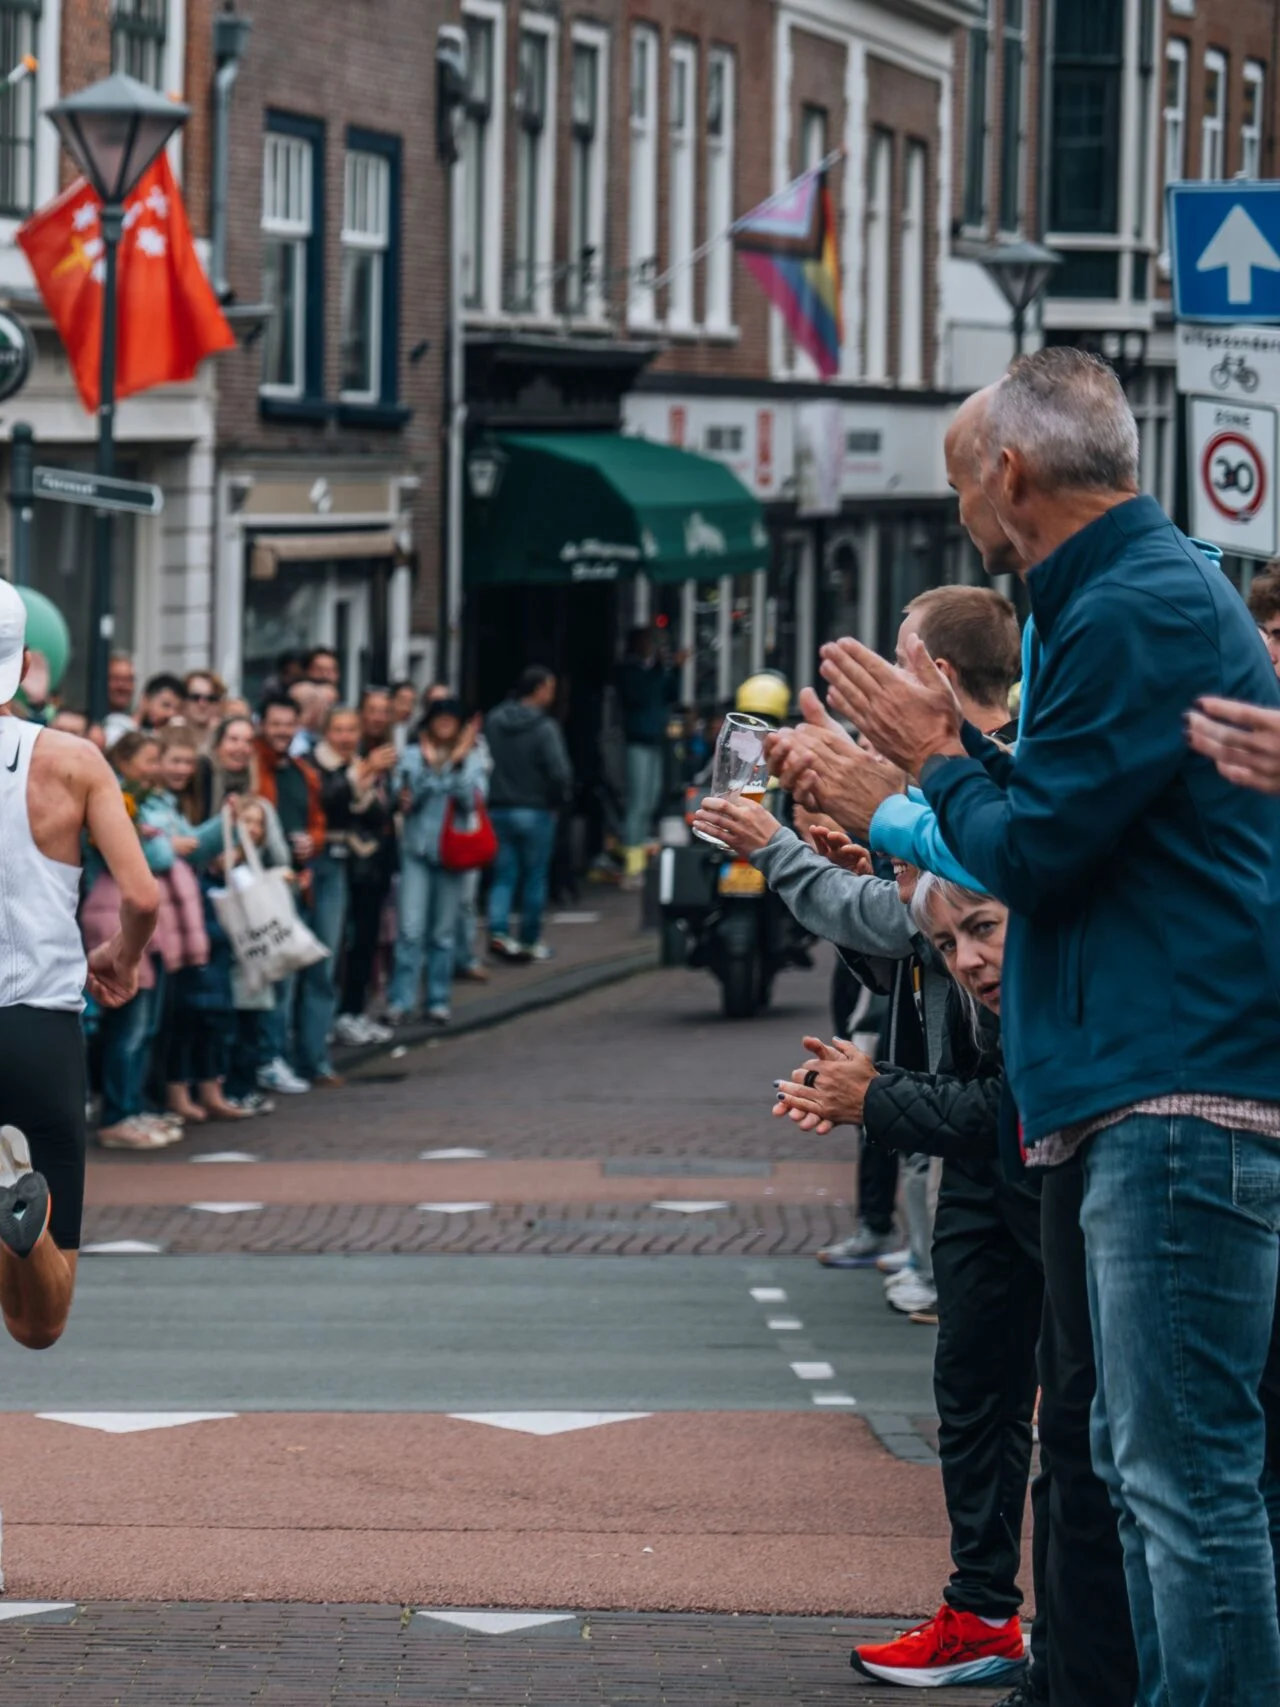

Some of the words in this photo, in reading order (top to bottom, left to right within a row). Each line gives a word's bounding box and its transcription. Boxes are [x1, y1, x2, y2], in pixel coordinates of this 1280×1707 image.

[1182, 331, 1280, 352] uitgezonder
[1214, 409, 1251, 427] ZONE
[1214, 457, 1254, 496] 30
